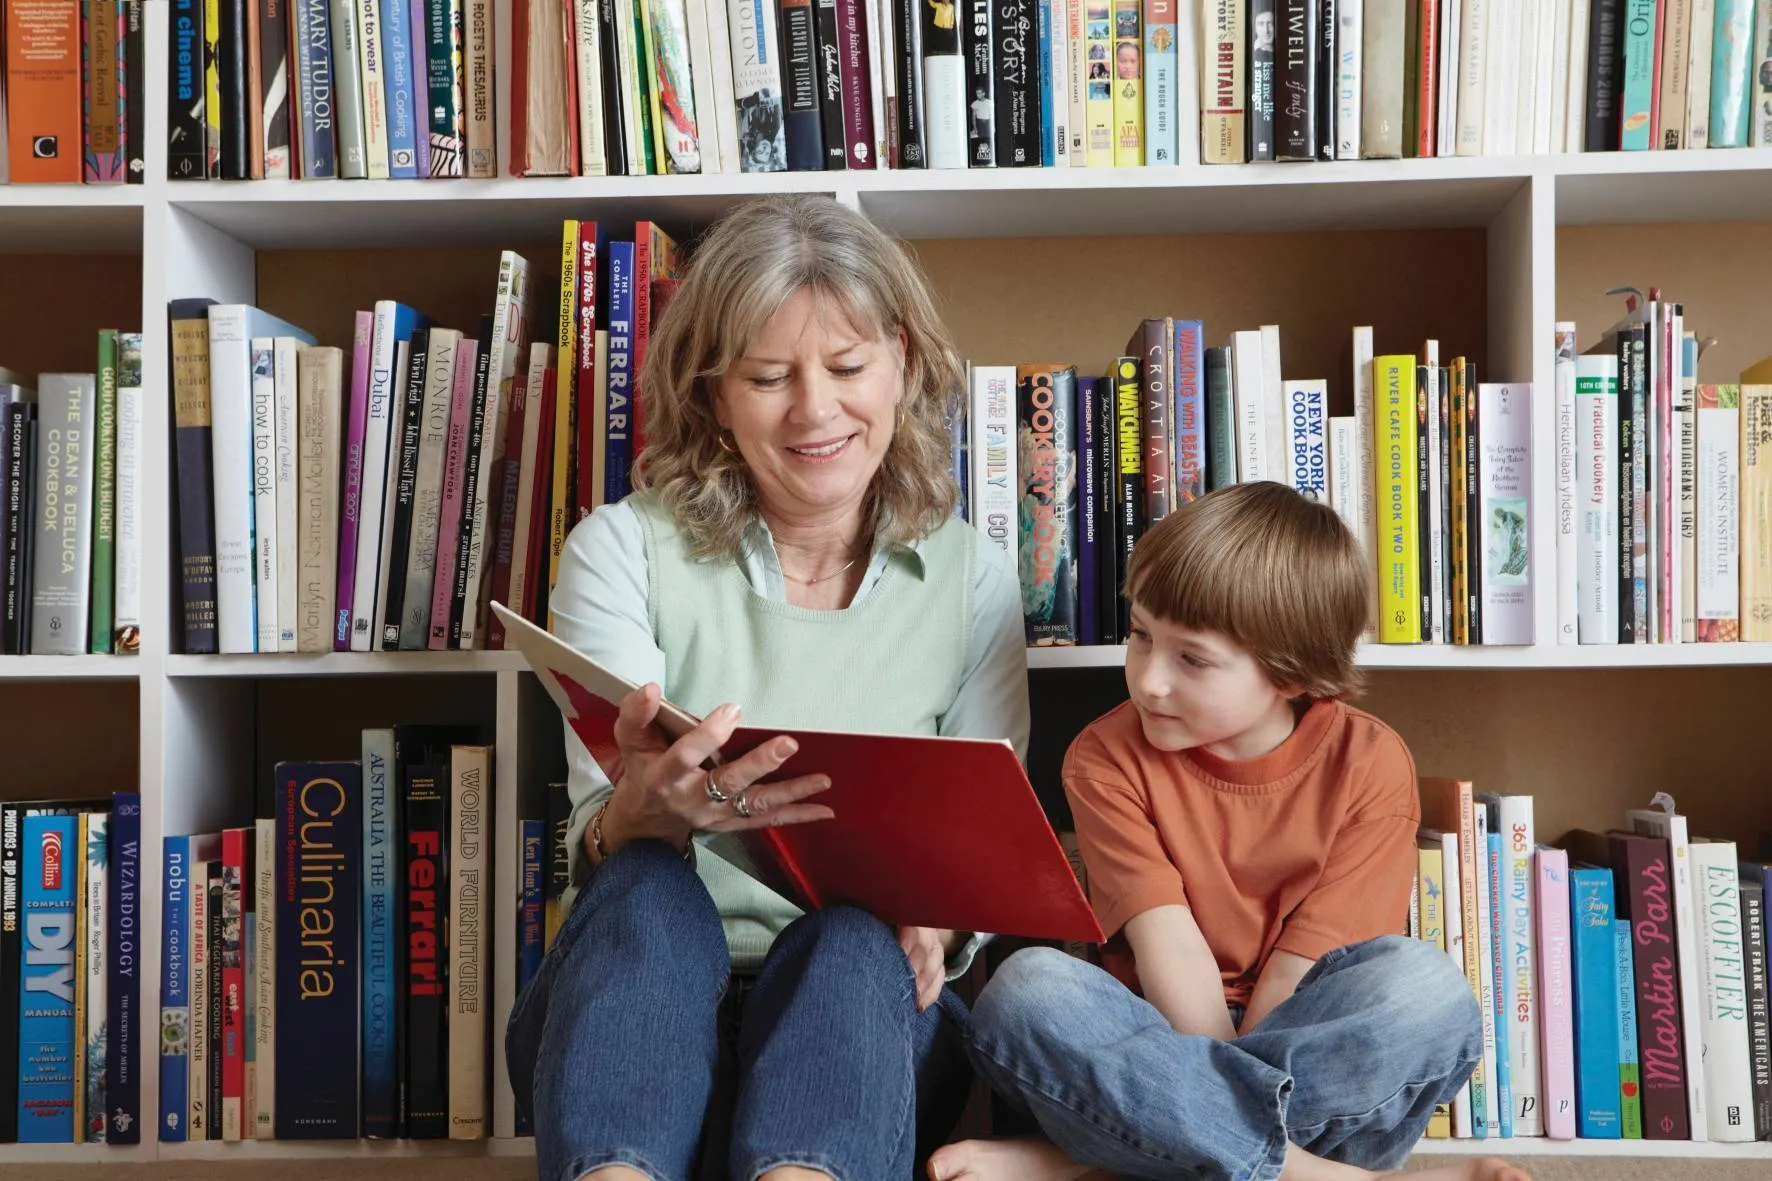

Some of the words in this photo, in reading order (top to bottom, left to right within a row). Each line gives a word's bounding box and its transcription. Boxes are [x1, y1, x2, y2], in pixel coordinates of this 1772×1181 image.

[96, 16, 108, 26] of
[299, 6, 308, 40] ANNA
[309, 0, 328, 51] MARY
[473, 3, 484, 51] ROGET'S
[846, 17, 856, 31] my
[847, 5, 855, 15] in
[975, 2, 987, 37] LES
[97, 30, 109, 66] Gothic
[790, 10, 809, 63] ATTRACTION
[849, 33, 860, 68] kitchen
[1001, 6, 1019, 84] STORY
[1598, 12, 1615, 75] AWARDS
[178, 17, 196, 100] cinema
[980, 43, 989, 74] Graham
[1157, 69, 1166, 82] THE
[1217, 42, 1234, 107] BRITAIN
[1263, 62, 1273, 81] kiss
[96, 68, 110, 106] Revival
[300, 44, 312, 118] WHITELOCK
[313, 56, 330, 131] TUDOR
[474, 55, 486, 122] THESAURUS
[793, 67, 813, 108] OPPOSITE
[1157, 85, 1166, 108] ROUGH
[1263, 83, 1271, 100] me
[1595, 79, 1612, 119] 2004
[854, 97, 862, 132] GYNGELL
[1157, 111, 1166, 133] GUIDE
[1263, 102, 1273, 122] like
[34, 137, 56, 157] C
[1057, 126, 1065, 155] ELEMENT
[563, 240, 572, 257] The
[582, 240, 596, 267] The
[638, 241, 647, 257] The
[562, 258, 574, 287] 1960s
[582, 269, 594, 303] 1970s
[612, 259, 621, 311] COMPLETE
[620, 275, 629, 294] THE
[638, 259, 647, 283] 1950s
[559, 290, 573, 348] Scrapbook
[637, 283, 647, 340] SCRAPBOOK
[580, 305, 595, 370] Scrapbook
[410, 352, 425, 379] Vivien
[608, 319, 629, 441] FERRARI
[1179, 329, 1199, 397] WALKING
[407, 380, 423, 405] Leigh
[427, 344, 452, 443] MONROE
[987, 378, 997, 419] COTTAGE
[1149, 344, 1164, 456] CROATIA
[1389, 367, 1400, 405] RIVER
[67, 387, 82, 423] THE
[120, 393, 138, 450] cooking
[254, 394, 271, 429] how
[279, 396, 291, 444] American
[1084, 389, 1092, 444] SAINSBURY'S
[1182, 402, 1195, 430] WITH
[1247, 401, 1257, 427] THE
[1307, 392, 1322, 436] NEW
[256, 434, 271, 450] to
[405, 422, 418, 445] John
[449, 423, 461, 451] JOAN
[1031, 372, 1055, 499] COOKERY
[1118, 383, 1140, 474] WATCHMEN
[1292, 391, 1308, 492] COOKBOOK
[1390, 410, 1402, 440] CAFE
[1591, 397, 1605, 451] Practical
[1746, 395, 1759, 467] Nutrition
[65, 429, 80, 478] DEAN
[987, 423, 1008, 488] FAMILY
[1181, 434, 1201, 485] BEASTS
[1559, 403, 1574, 483] Herkutellaan
[123, 455, 138, 468] in
[256, 456, 272, 496] cook
[277, 445, 292, 483] Cooking
[401, 446, 417, 479] Russell
[446, 452, 458, 501] CRAWFORD
[1086, 448, 1095, 494] microwave
[1308, 445, 1326, 494] YORK
[1390, 444, 1402, 480] COOK
[1590, 454, 1606, 505] Cookery
[44, 429, 60, 532] COOKBOOK
[65, 484, 79, 497] &
[397, 480, 414, 506] Taylor
[498, 460, 521, 525] MALEDE
[1125, 483, 1134, 501] ALAN
[1152, 474, 1165, 496] AT
[1716, 450, 1728, 512] WOMEN'S
[120, 474, 138, 540] provence
[1085, 495, 1096, 543] companion
[1125, 502, 1134, 526] MOORE
[1392, 485, 1403, 520] BOOK
[61, 503, 77, 573] DELUCA
[553, 508, 563, 535] Robert
[1392, 525, 1405, 554] TWO
[262, 537, 271, 557] lesley
[497, 528, 513, 564] RUM
[552, 537, 562, 557] Opie
[1031, 503, 1056, 587] BOOK
[1126, 535, 1135, 552] DAVE
[1716, 514, 1728, 577] INSTITUTE
[262, 559, 271, 581] waters
[1594, 550, 1603, 581] Hodder
[1594, 583, 1603, 614] Arnold
[286, 780, 297, 836] European
[368, 753, 385, 848] AUSTRALIA
[459, 767, 480, 860] WORLD
[1461, 793, 1471, 820] HARRIS
[3, 809, 17, 849] PHOTO93
[1463, 828, 1473, 864] EMBERLEY
[1512, 822, 1527, 853] 365
[43, 845, 59, 887] Collins
[525, 836, 540, 860] Ken
[3, 859, 17, 876] BJP
[167, 852, 187, 901] nobu
[285, 838, 297, 902] Specialties
[369, 851, 384, 888] THE
[525, 862, 540, 897] Hom's
[1509, 857, 1530, 901] Rainy
[3, 876, 17, 911] ANNUAL
[194, 883, 203, 891] A
[194, 892, 203, 917] TASTE
[299, 777, 348, 1001] Culinaria
[1464, 877, 1473, 896] LET'S
[1635, 858, 1672, 946] Parr
[3, 911, 17, 932] 1993
[408, 829, 443, 998] Ferrari
[525, 903, 539, 923] Hot
[1427, 903, 1437, 921] THE
[1465, 896, 1474, 916] TALK
[1509, 906, 1528, 938] Day
[1748, 900, 1761, 946] ROBERT
[194, 919, 203, 931] OF
[370, 893, 385, 988] BEAUTIFUL
[458, 869, 479, 1015] FURNITURE
[524, 923, 538, 946] Wok
[1465, 916, 1475, 941] ABOUT
[25, 912, 75, 1003] DIY
[194, 932, 204, 964] AFRICA
[1466, 941, 1476, 967] WHERE
[1707, 865, 1745, 1023] ESCOFFIER
[168, 928, 181, 997] cookbook
[1751, 952, 1763, 991] FRANK
[192, 968, 203, 1017] DORINDA
[1515, 941, 1532, 1024] Activities
[1642, 957, 1680, 1082] Martin
[1752, 997, 1765, 1017] THE
[193, 1019, 203, 1062] HAFNER
[1754, 1020, 1769, 1086] AMERICANS
[1474, 1082, 1485, 1109] BOOKS
[452, 1115, 484, 1125] Crescent
